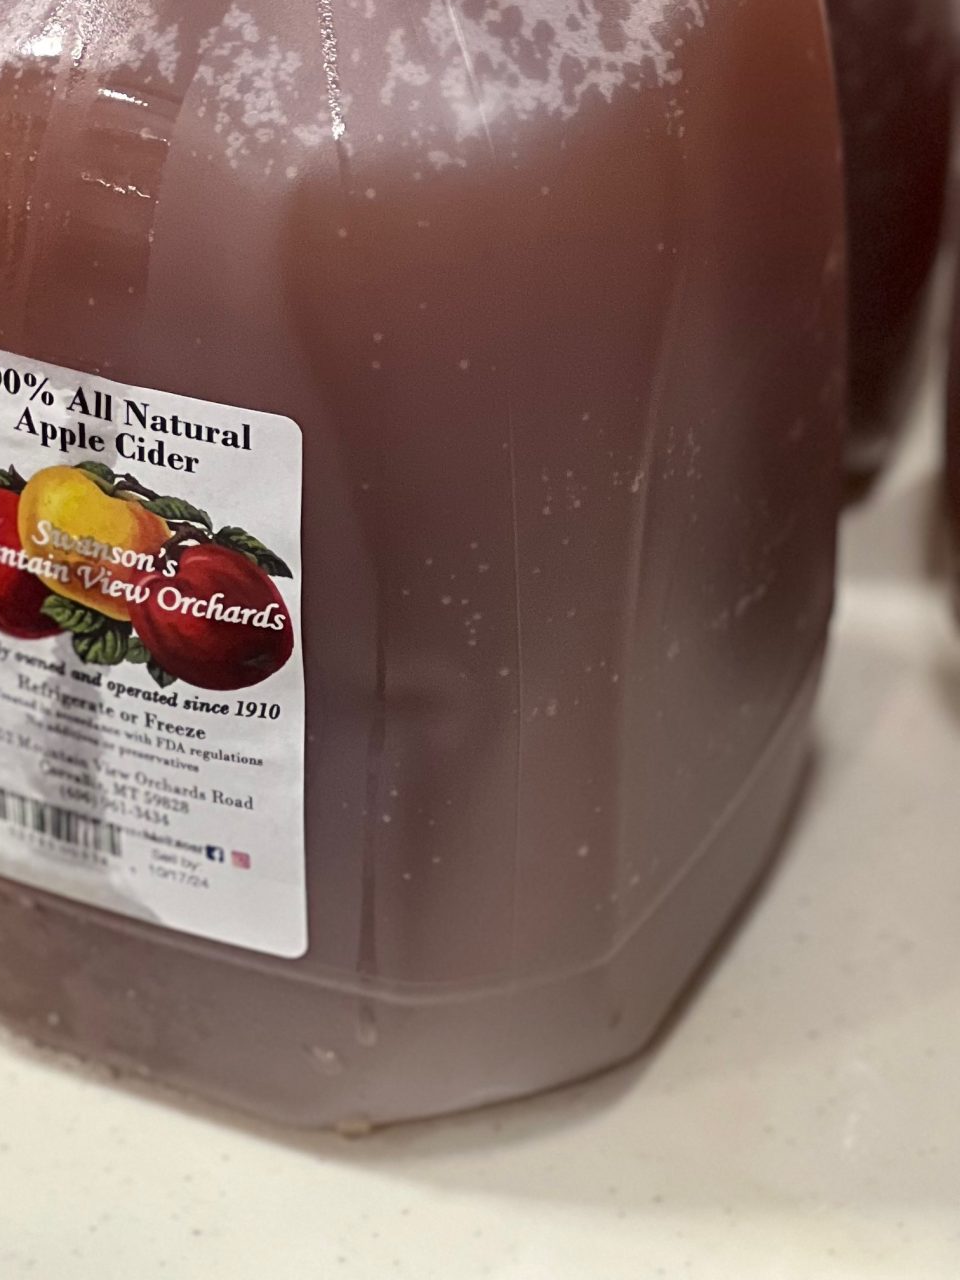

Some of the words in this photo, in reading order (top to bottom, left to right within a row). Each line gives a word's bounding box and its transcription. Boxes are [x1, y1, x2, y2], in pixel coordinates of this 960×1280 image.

[14, 407, 105, 453] Apple
[115, 432, 199, 473] Cider
[66, 386, 113, 422] All
[123, 399, 252, 451] Natural
[32, 519, 178, 578] Swanson's
[76, 564, 151, 604] View
[157, 586, 286, 631] Orchards
[14, 651, 67, 680] owned
[70, 666, 103, 687] and
[107, 675, 178, 708] operated
[183, 695, 230, 717] since
[234, 700, 282, 721] 1910
[17, 673, 115, 719] Refrigerate
[120, 710, 139, 724] or
[144, 712, 208, 741] Freeze
[119, 745, 201, 774] preservatives
[124, 727, 152, 746] with
[156, 733, 187, 755] FDA
[190, 746, 265, 769] regulations
[112, 782, 141, 803] MT
[135, 770, 207, 802] Orchards
[211, 789, 255, 811] Road
